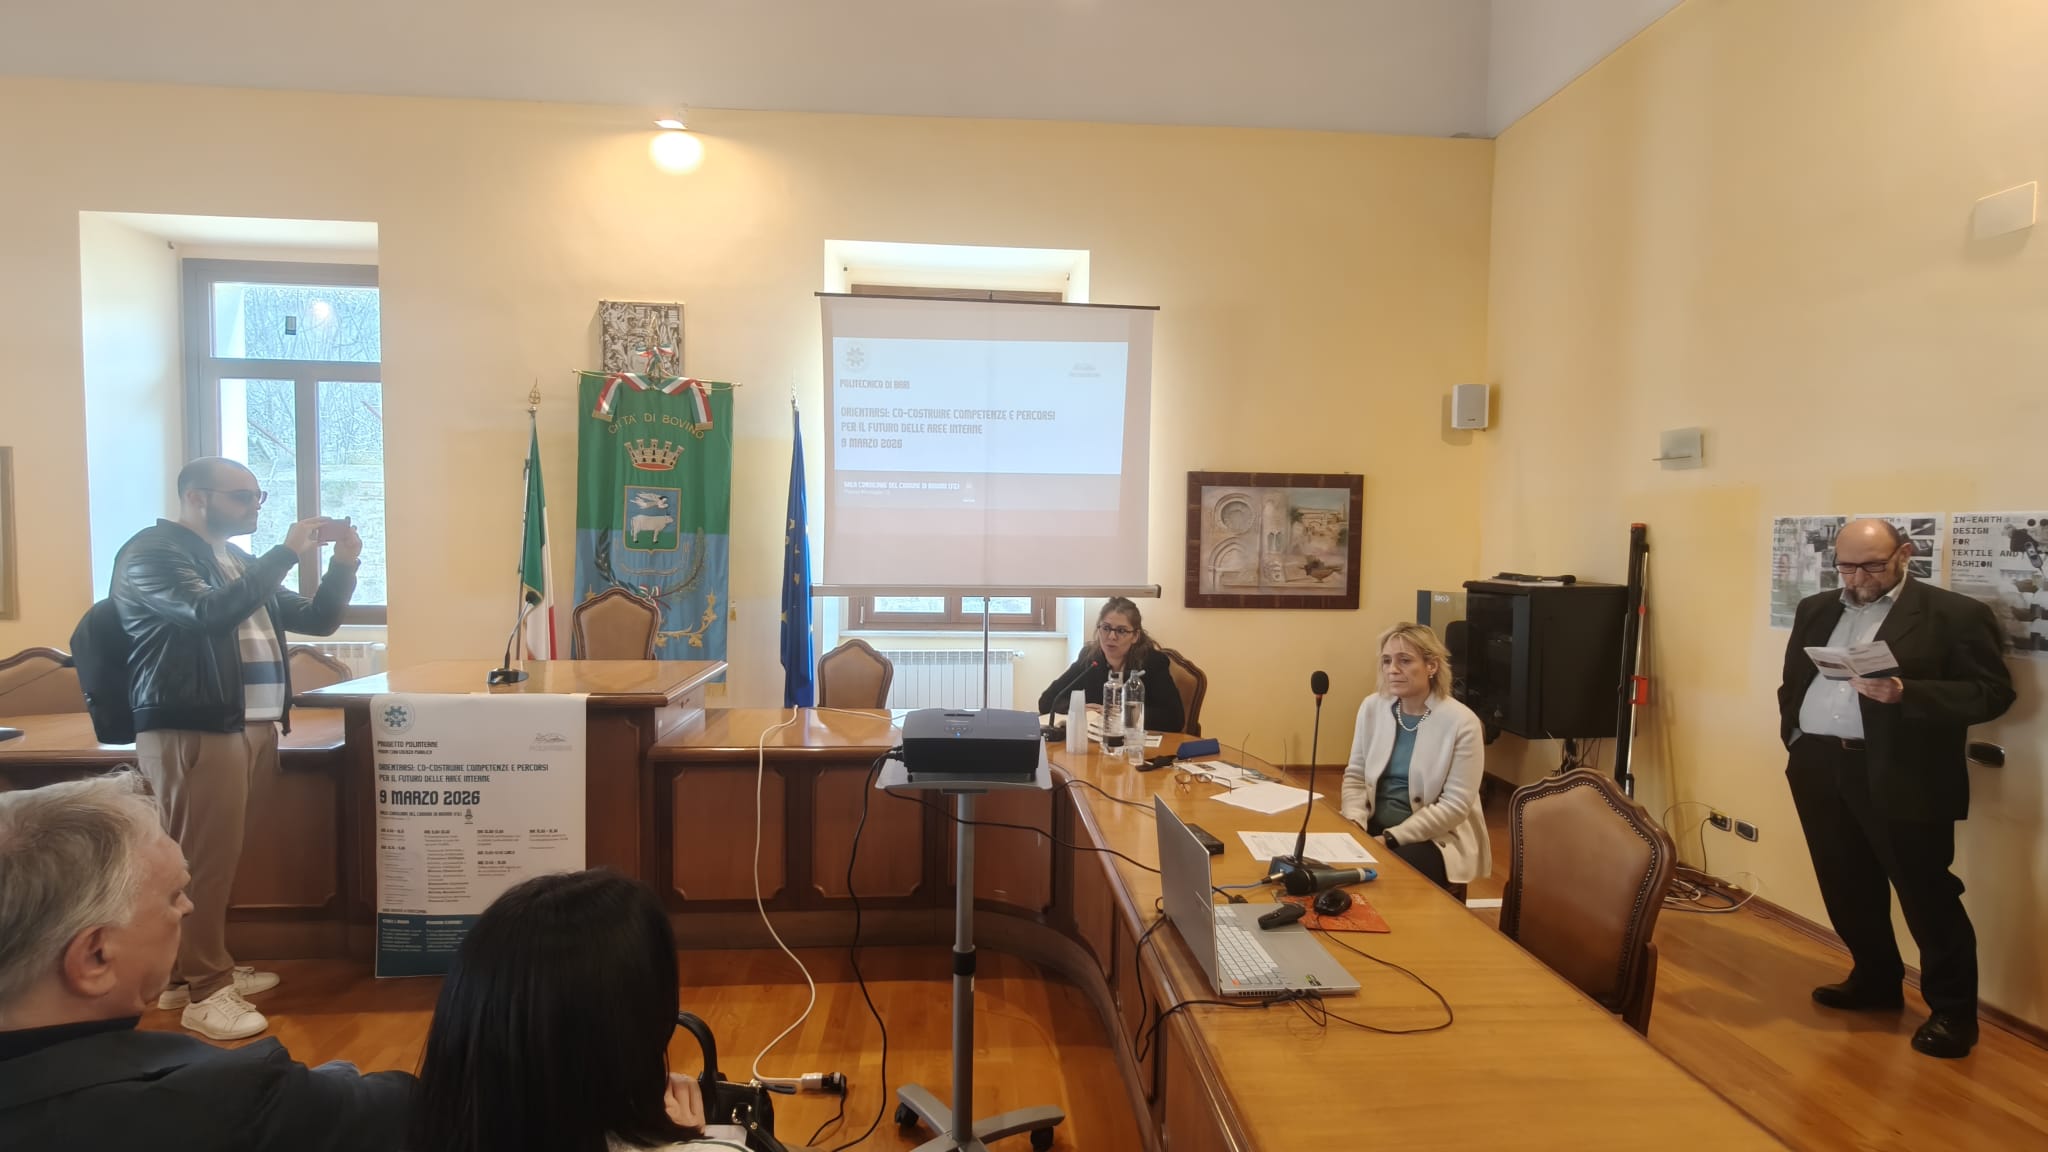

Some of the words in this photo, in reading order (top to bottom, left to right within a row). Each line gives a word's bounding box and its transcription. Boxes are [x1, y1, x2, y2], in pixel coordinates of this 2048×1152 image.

[885, 380, 892, 389] DI
[892, 408, 951, 419] CO-COSTRUIRE
[954, 409, 1007, 420] COMPETENZE
[1009, 410, 1014, 420] E
[1016, 410, 1056, 421] PERCORSI
[644, 413, 656, 422] DI
[662, 415, 704, 439] BOVINO
[841, 422, 857, 432] PER
[859, 423, 866, 432] IL
[868, 423, 899, 433] FUTURO
[901, 423, 925, 433] DELLE
[927, 424, 948, 434] AREE
[950, 424, 983, 434] INTERNE
[841, 438, 847, 448] 9
[849, 438, 878, 448] MARZO
[881, 438, 902, 448] 2026
[1953, 516, 2002, 524] IN-EARTH
[1952, 527, 1989, 535] DESIGN
[1952, 549, 1993, 557] TEXTILE
[2000, 550, 2019, 558] AND
[1952, 559, 1993, 568] FASHION
[417, 764, 464, 772] CO-COSTRUIRE
[466, 764, 509, 772] COMPETENZE
[517, 763, 549, 771] PERCORSI
[379, 774, 390, 782] PER
[399, 775, 423, 783] FUTURO
[424, 775, 442, 783] DELLE
[445, 775, 462, 783] AREE
[464, 775, 490, 783] INTERNE
[380, 789, 387, 804] 9
[391, 790, 439, 805] MARZO
[443, 790, 481, 805] 2026
